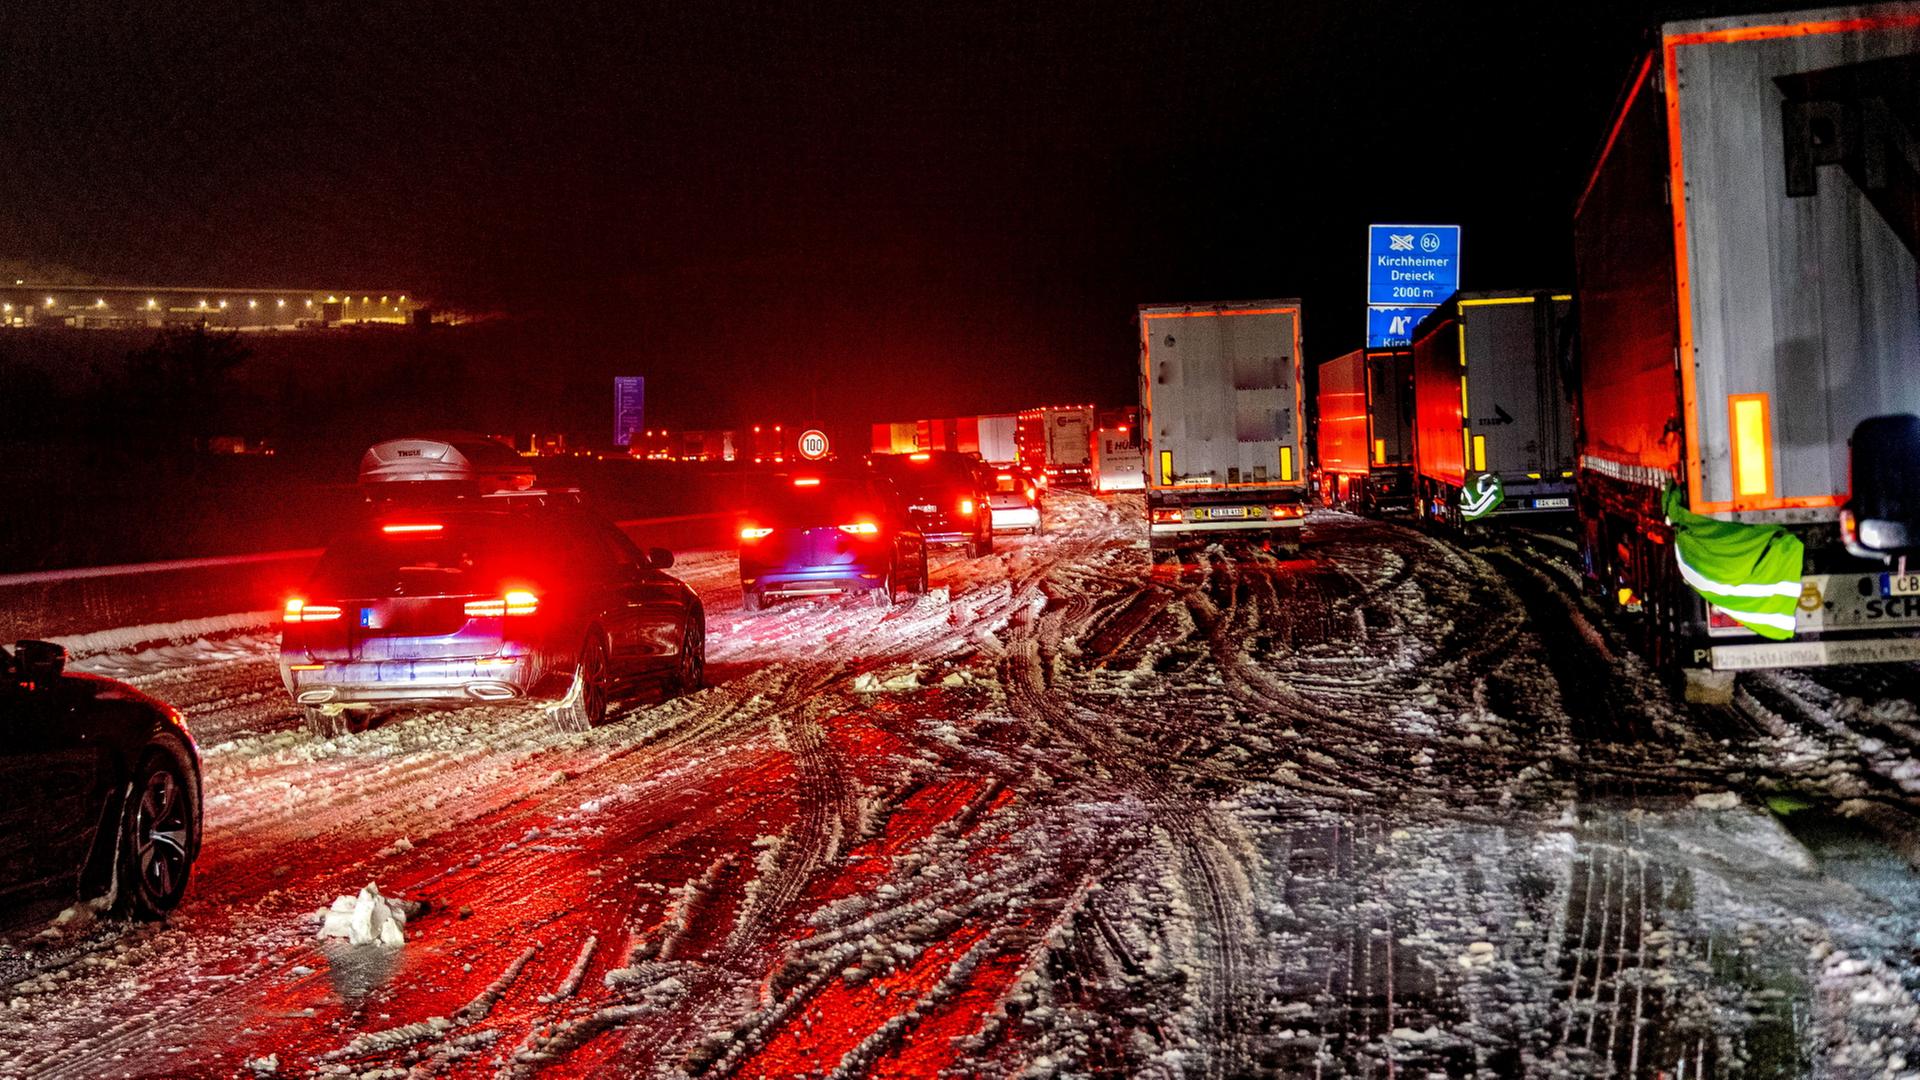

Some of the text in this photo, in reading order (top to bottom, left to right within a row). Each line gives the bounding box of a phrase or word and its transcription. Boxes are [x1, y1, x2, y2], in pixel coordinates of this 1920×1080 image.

[1422, 237, 1437, 248] 86
[1378, 256, 1449, 266] Kirchheimer
[1391, 270, 1435, 281] Dreieck
[1392, 287, 1434, 297] 2000 m
[806, 438, 822, 451] 100
[1866, 598, 1920, 619] SCH
